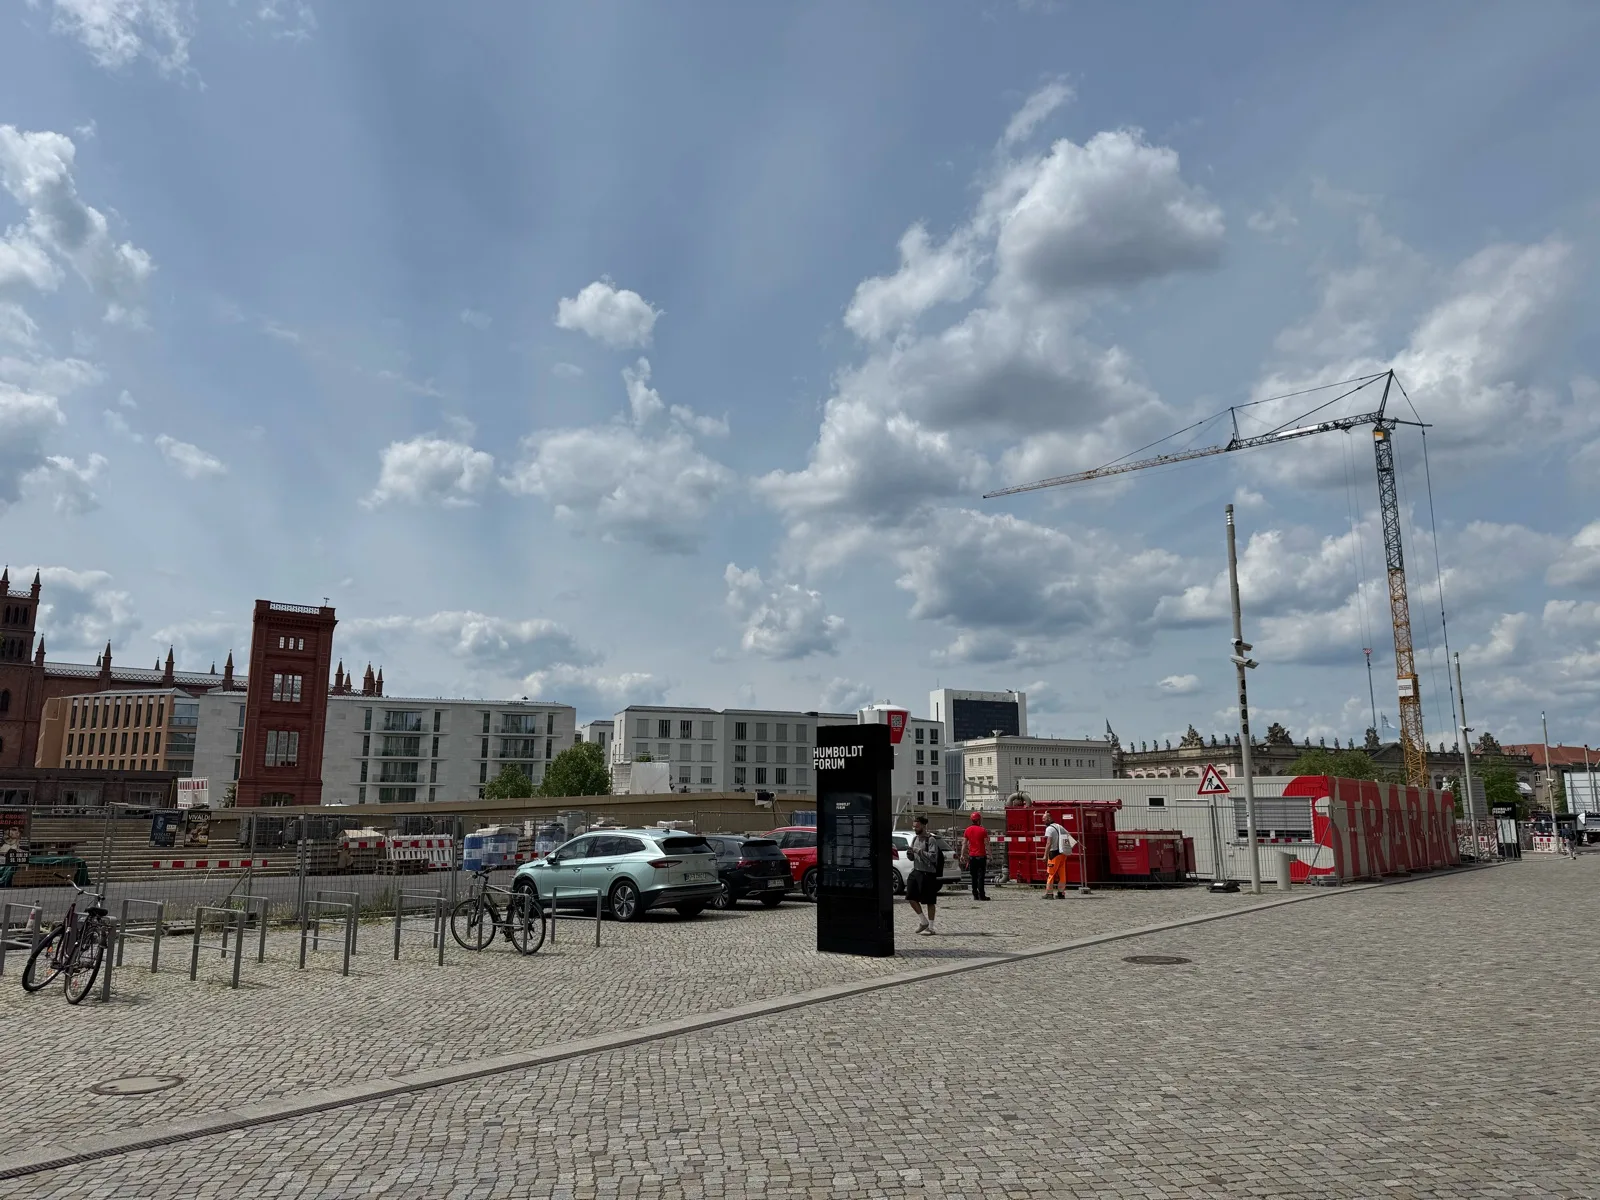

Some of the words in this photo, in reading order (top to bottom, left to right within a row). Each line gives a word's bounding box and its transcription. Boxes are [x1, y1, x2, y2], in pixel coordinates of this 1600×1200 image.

[813, 745, 864, 758] HUMBOLDT
[813, 758, 845, 770] FORUM
[1284, 775, 1460, 881] STRABAG
